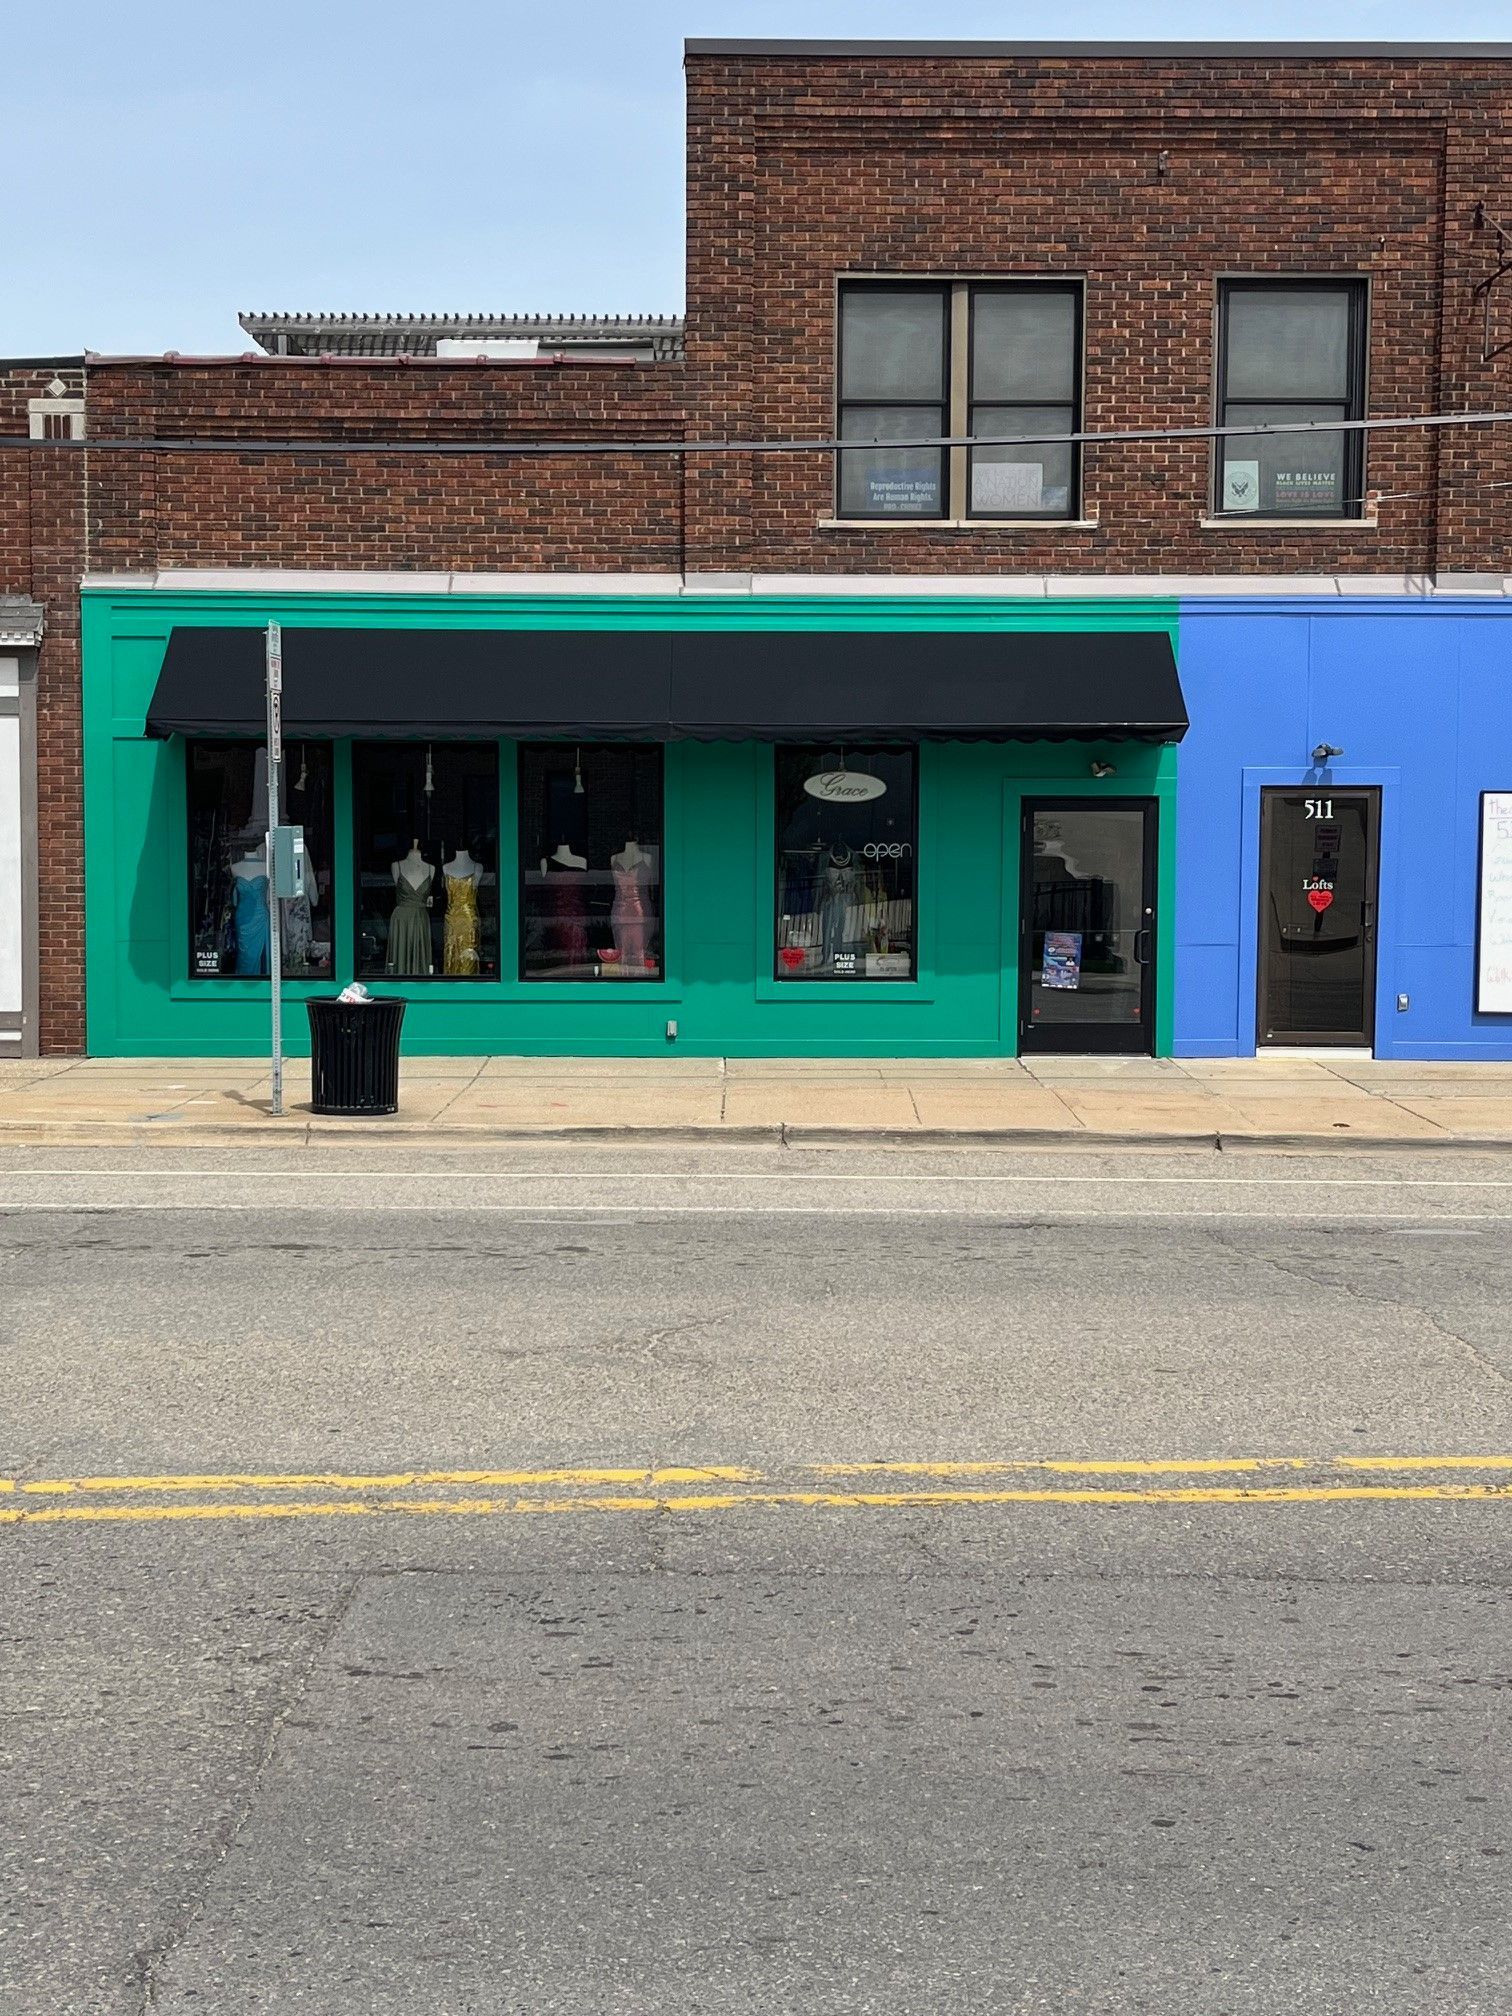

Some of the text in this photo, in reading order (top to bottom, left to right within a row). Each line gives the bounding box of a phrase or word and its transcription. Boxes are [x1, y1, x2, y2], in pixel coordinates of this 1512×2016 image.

[870, 482, 936, 492] Reproductive Rights
[873, 493, 884, 501] Are
[885, 493, 909, 501] Human
[974, 494, 1039, 507] WOMEN
[820, 772, 869, 797] Grace
[1304, 799, 1334, 820] 511
[863, 843, 912, 862] open
[1302, 879, 1334, 890] Lofts
[196, 951, 219, 959] PLUS
[834, 953, 856, 961] PLUS
[836, 961, 855, 969] SIZE
